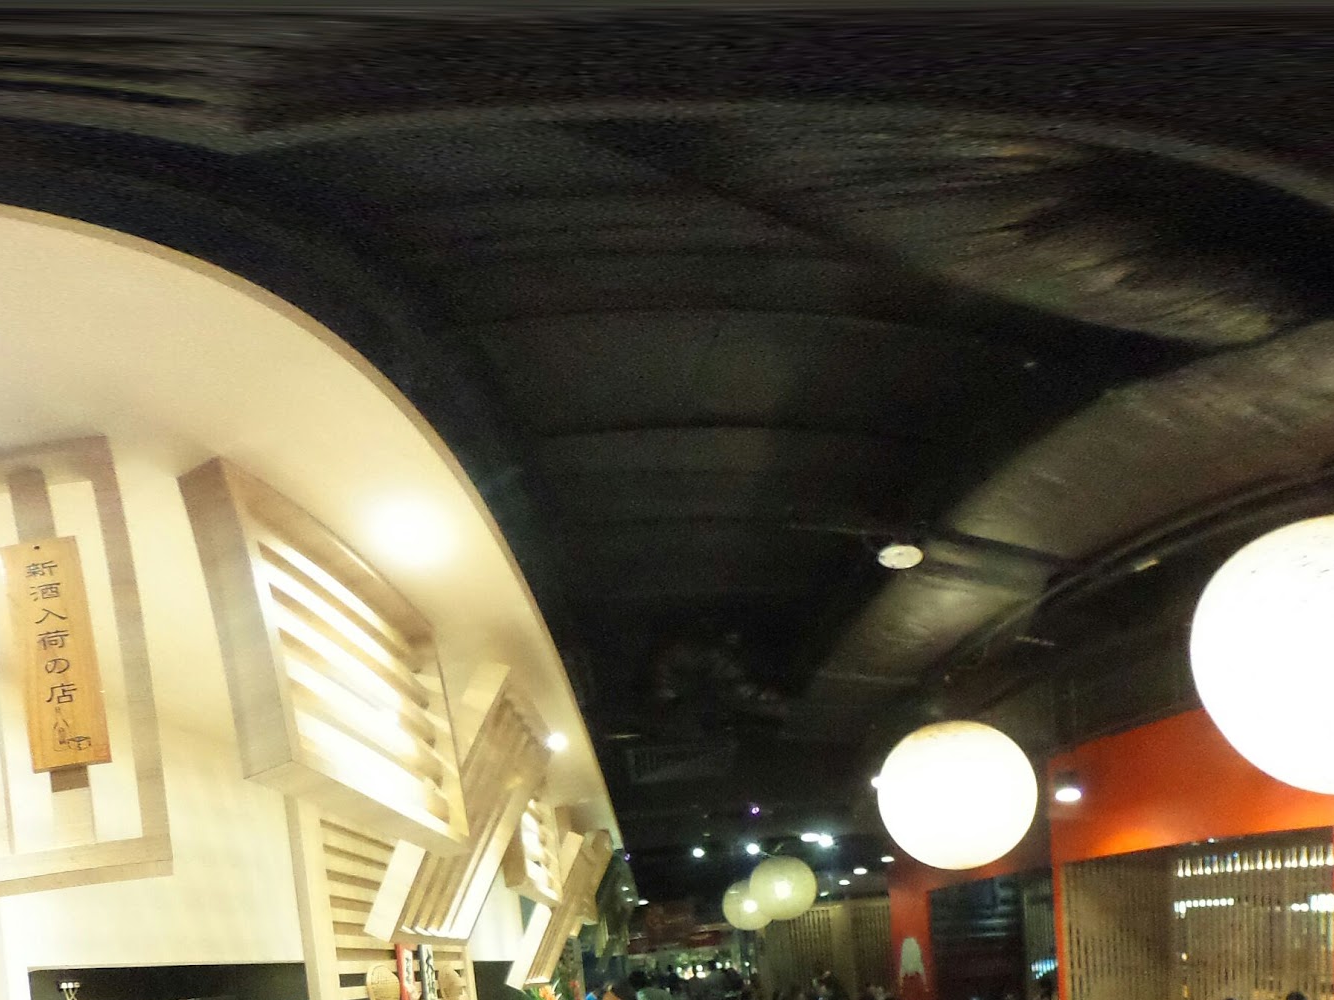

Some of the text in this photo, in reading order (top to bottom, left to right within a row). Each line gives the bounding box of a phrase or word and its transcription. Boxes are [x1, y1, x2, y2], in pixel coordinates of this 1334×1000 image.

[25, 560, 78, 704] 新酒入荷の店
